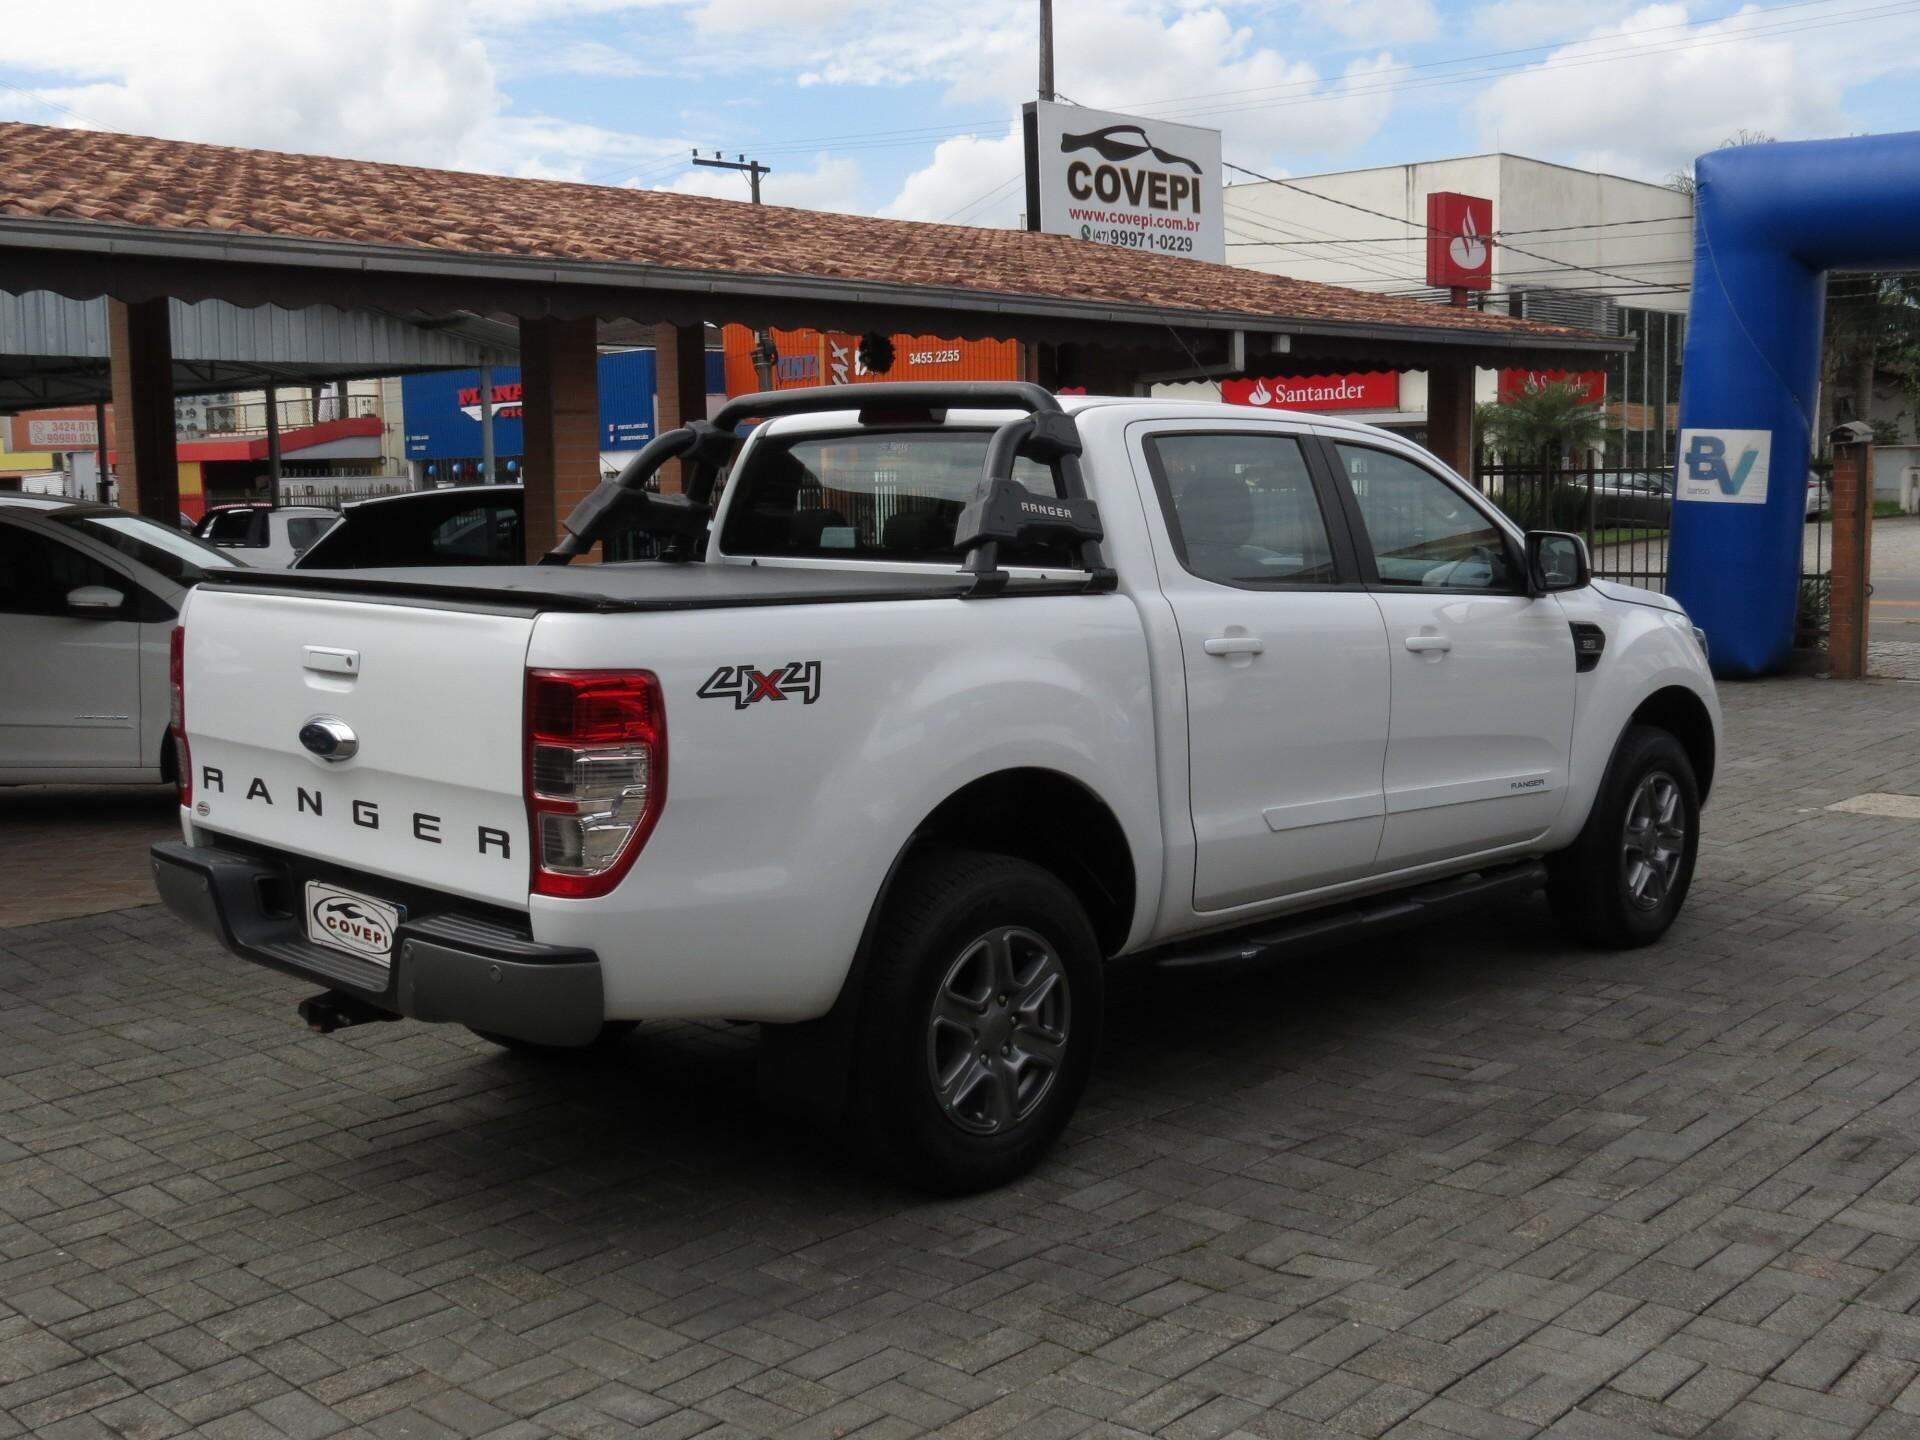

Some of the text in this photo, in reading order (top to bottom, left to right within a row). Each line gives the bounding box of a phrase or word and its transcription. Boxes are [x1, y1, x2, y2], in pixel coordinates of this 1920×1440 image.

[1067, 160, 1201, 214] COVEPI
[1069, 208, 1201, 232] www.covepi.com.br
[908, 349, 960, 365] 3455.2255
[1275, 378, 1365, 403] Santander
[1684, 435, 1760, 496] BV
[1020, 501, 1073, 519] RANGER
[1510, 778, 1545, 790] RANGER
[202, 765, 511, 860] RANGER
[326, 916, 389, 949] COVEPI
